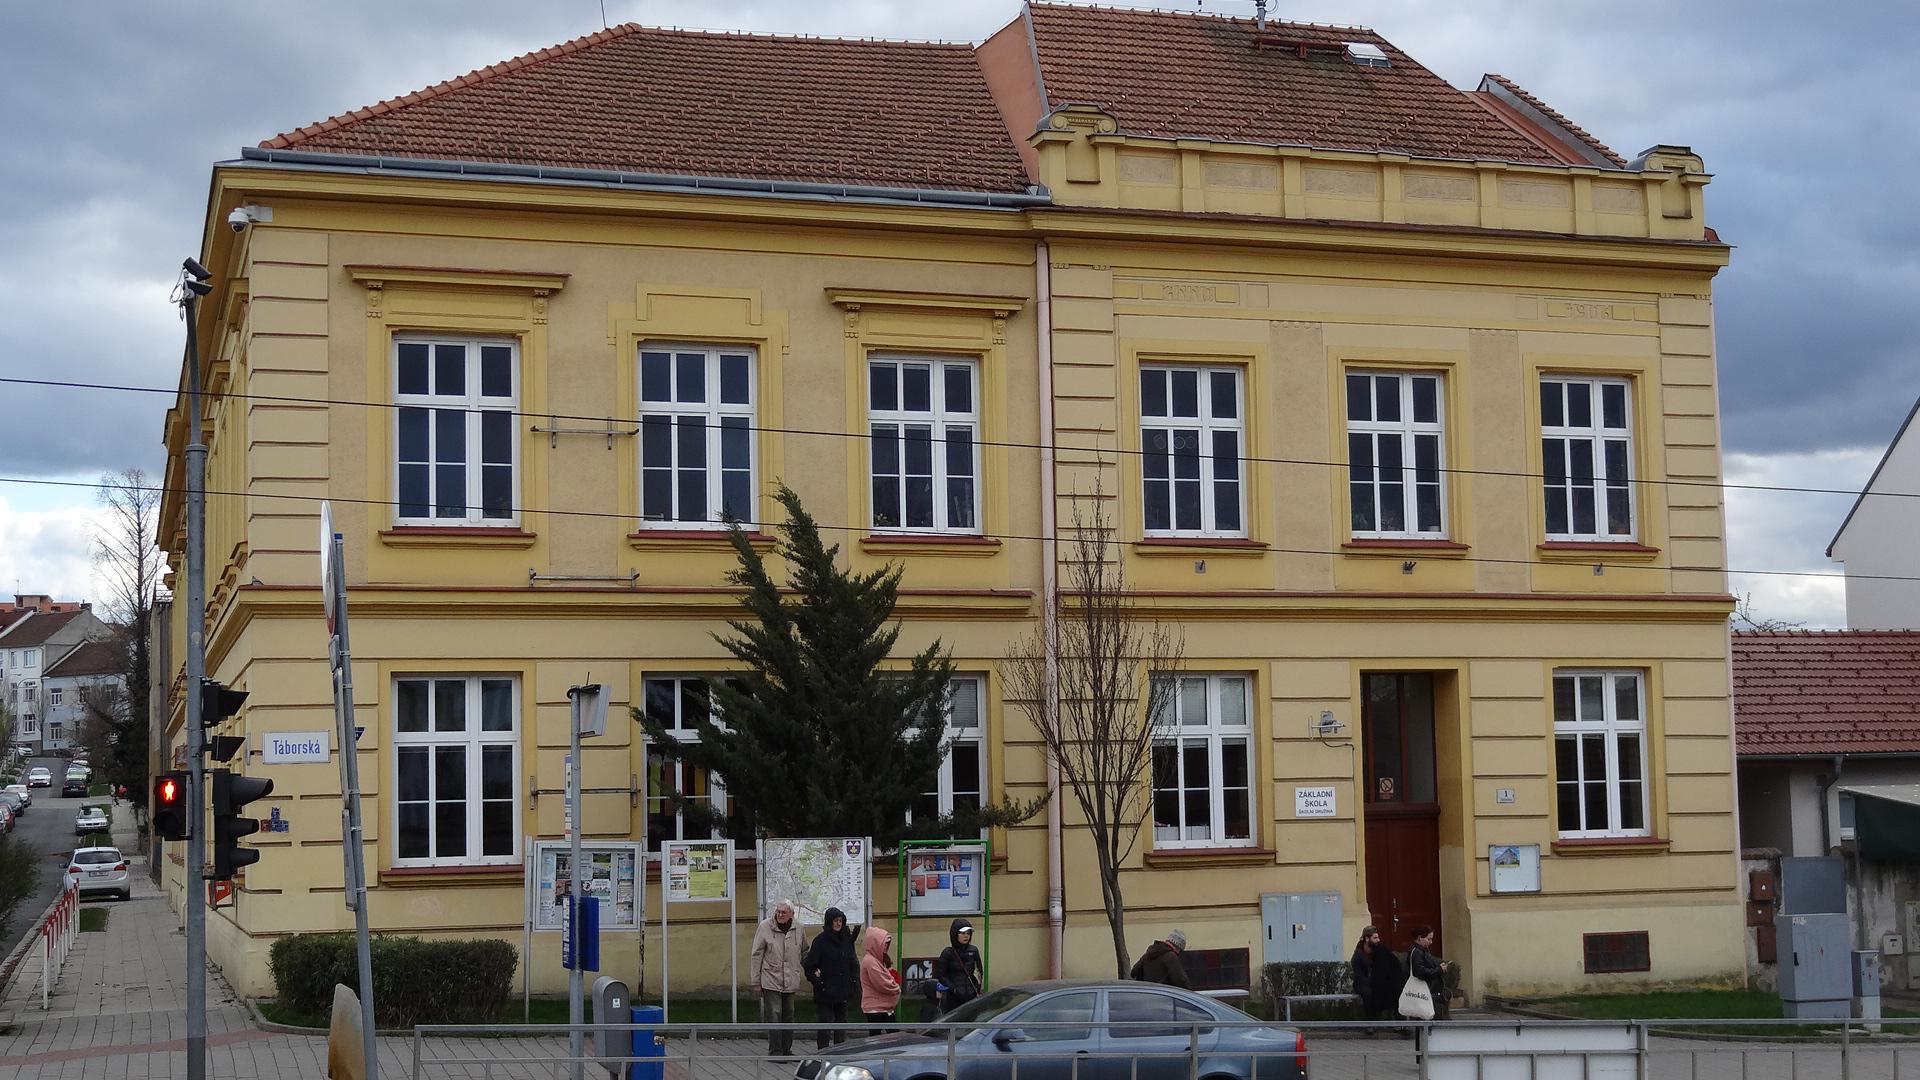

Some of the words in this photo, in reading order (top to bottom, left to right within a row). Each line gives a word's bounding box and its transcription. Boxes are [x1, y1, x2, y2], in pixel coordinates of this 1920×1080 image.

[273, 739, 321, 755] Táborská
[1299, 790, 1333, 798] ZÁKLADNÍ
[1304, 799, 1328, 807] ŠKOLA
